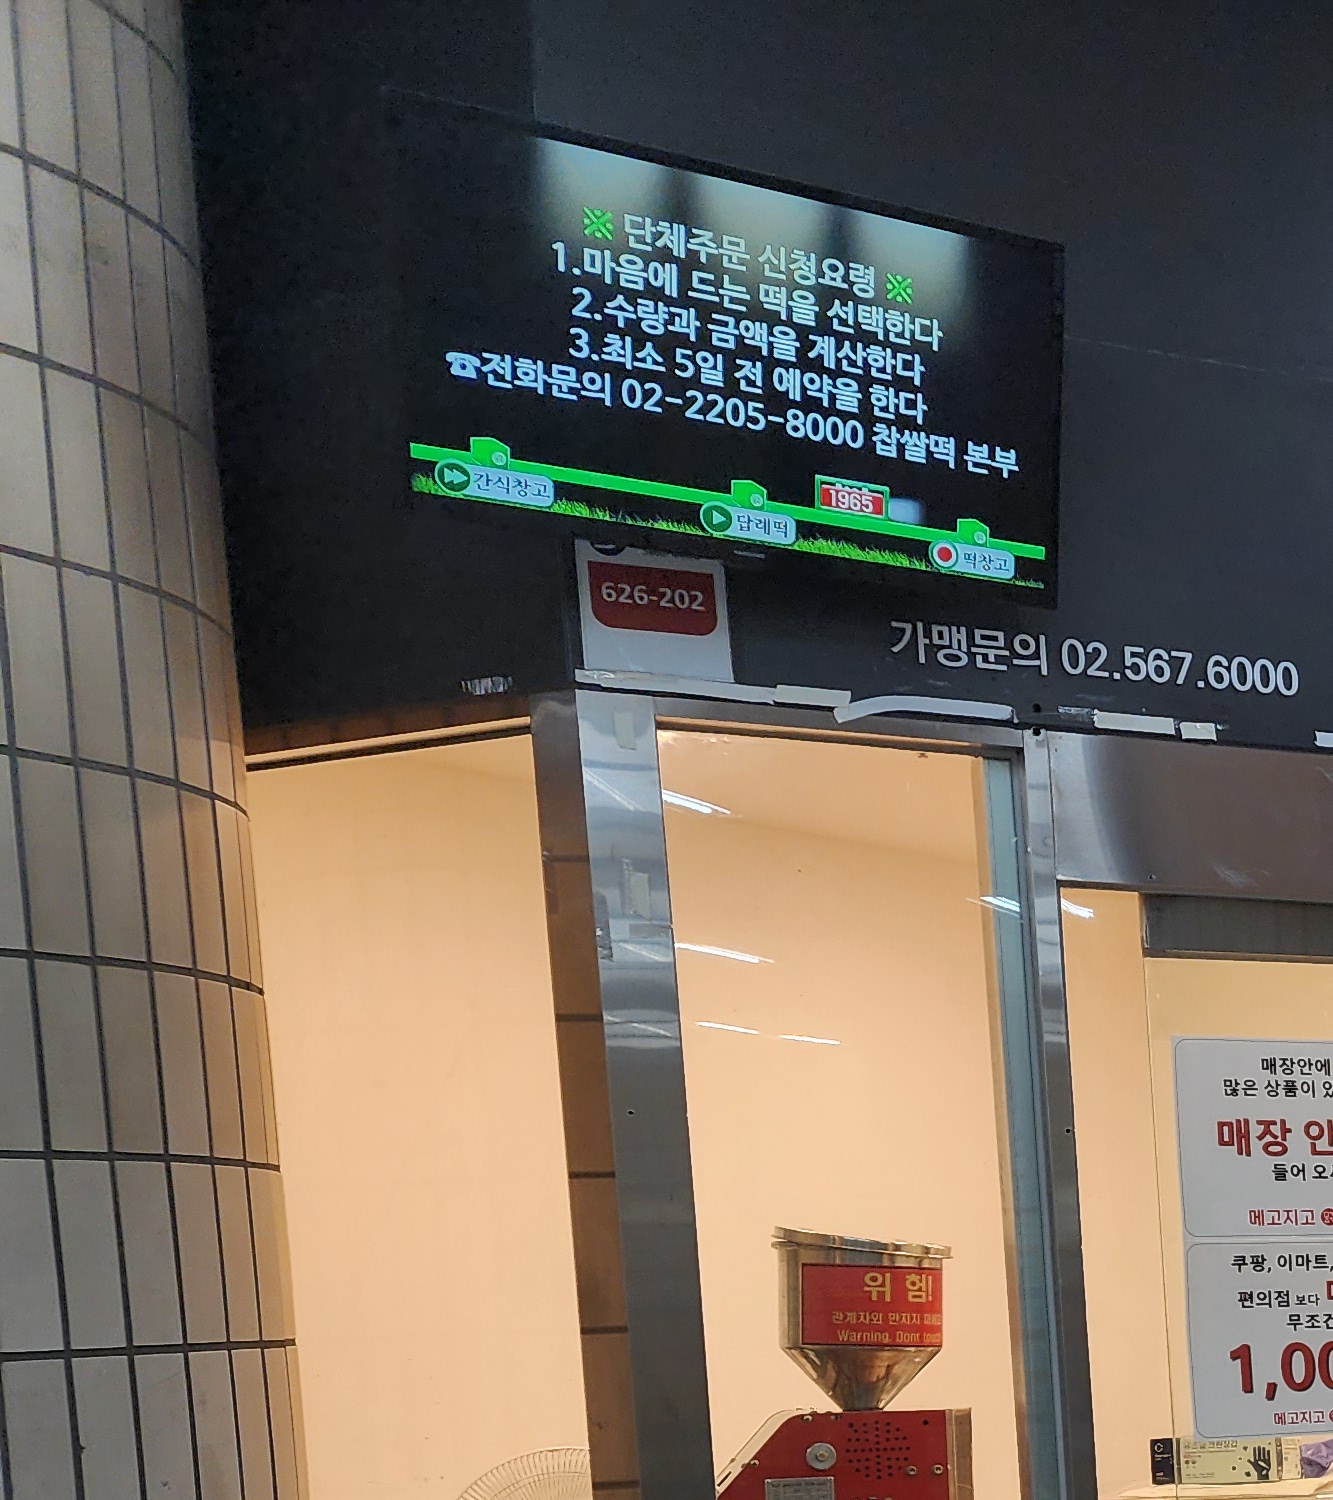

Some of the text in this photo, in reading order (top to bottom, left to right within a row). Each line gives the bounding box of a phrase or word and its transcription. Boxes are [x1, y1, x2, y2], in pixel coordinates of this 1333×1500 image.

[623, 213, 876, 295] 단체주문 신청요령
[550, 241, 943, 351] 1.마음에 드는 떡을 선택한다
[571, 288, 924, 387] 2.수량과 금액을 계산한다
[569, 327, 927, 425] 3.최소 5일 전 예약을 한다
[480, 352, 1019, 478] 전화문의 02-2205-8000 찹쌀떡 본부
[473, 468, 550, 500] 간식창고
[828, 488, 873, 513] 1965
[736, 513, 789, 538] 답례떡
[963, 550, 1009, 572] 떡창고
[600, 582, 706, 611] 626-202
[891, 619, 1299, 697] 가맹문의 02.567.6000
[1261, 1057, 1330, 1076] 매장안에
[1223, 1079, 1258, 1097] 많은
[1264, 1080, 1316, 1098] 상품이
[1217, 1118, 1292, 1157] 매장
[1272, 1163, 1306, 1181] 들어
[1249, 1209, 1315, 1227] 메고지고
[1231, 1254, 1272, 1273] 쿠팡,
[1277, 1254, 1333, 1272] 이마트,
[864, 1272, 891, 1302] 위
[1238, 1290, 1290, 1308] 편의점
[1295, 1295, 1320, 1306] 보다
[832, 1312, 882, 1324] 관계자외
[1274, 1411, 1325, 1425] 메고지고
